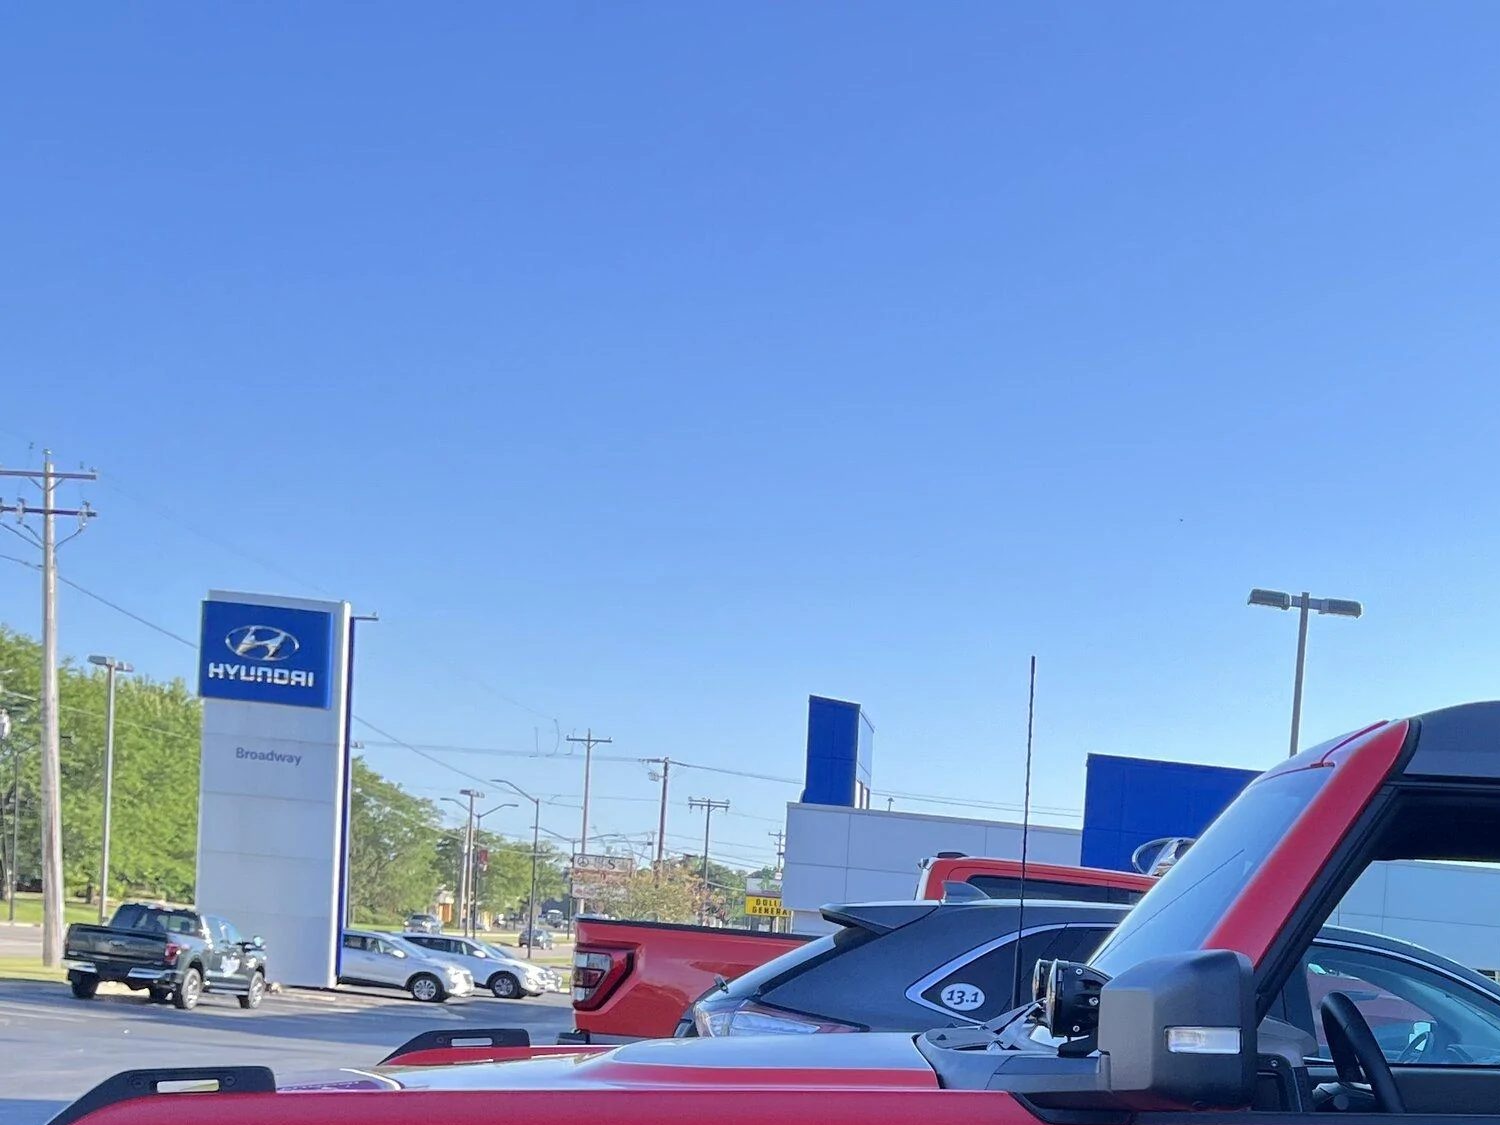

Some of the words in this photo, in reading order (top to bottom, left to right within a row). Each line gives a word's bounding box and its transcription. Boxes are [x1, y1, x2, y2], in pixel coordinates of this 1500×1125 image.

[209, 662, 314, 687] HYUNDAI
[235, 746, 302, 766] Broadway
[946, 989, 979, 1005] 13.1
